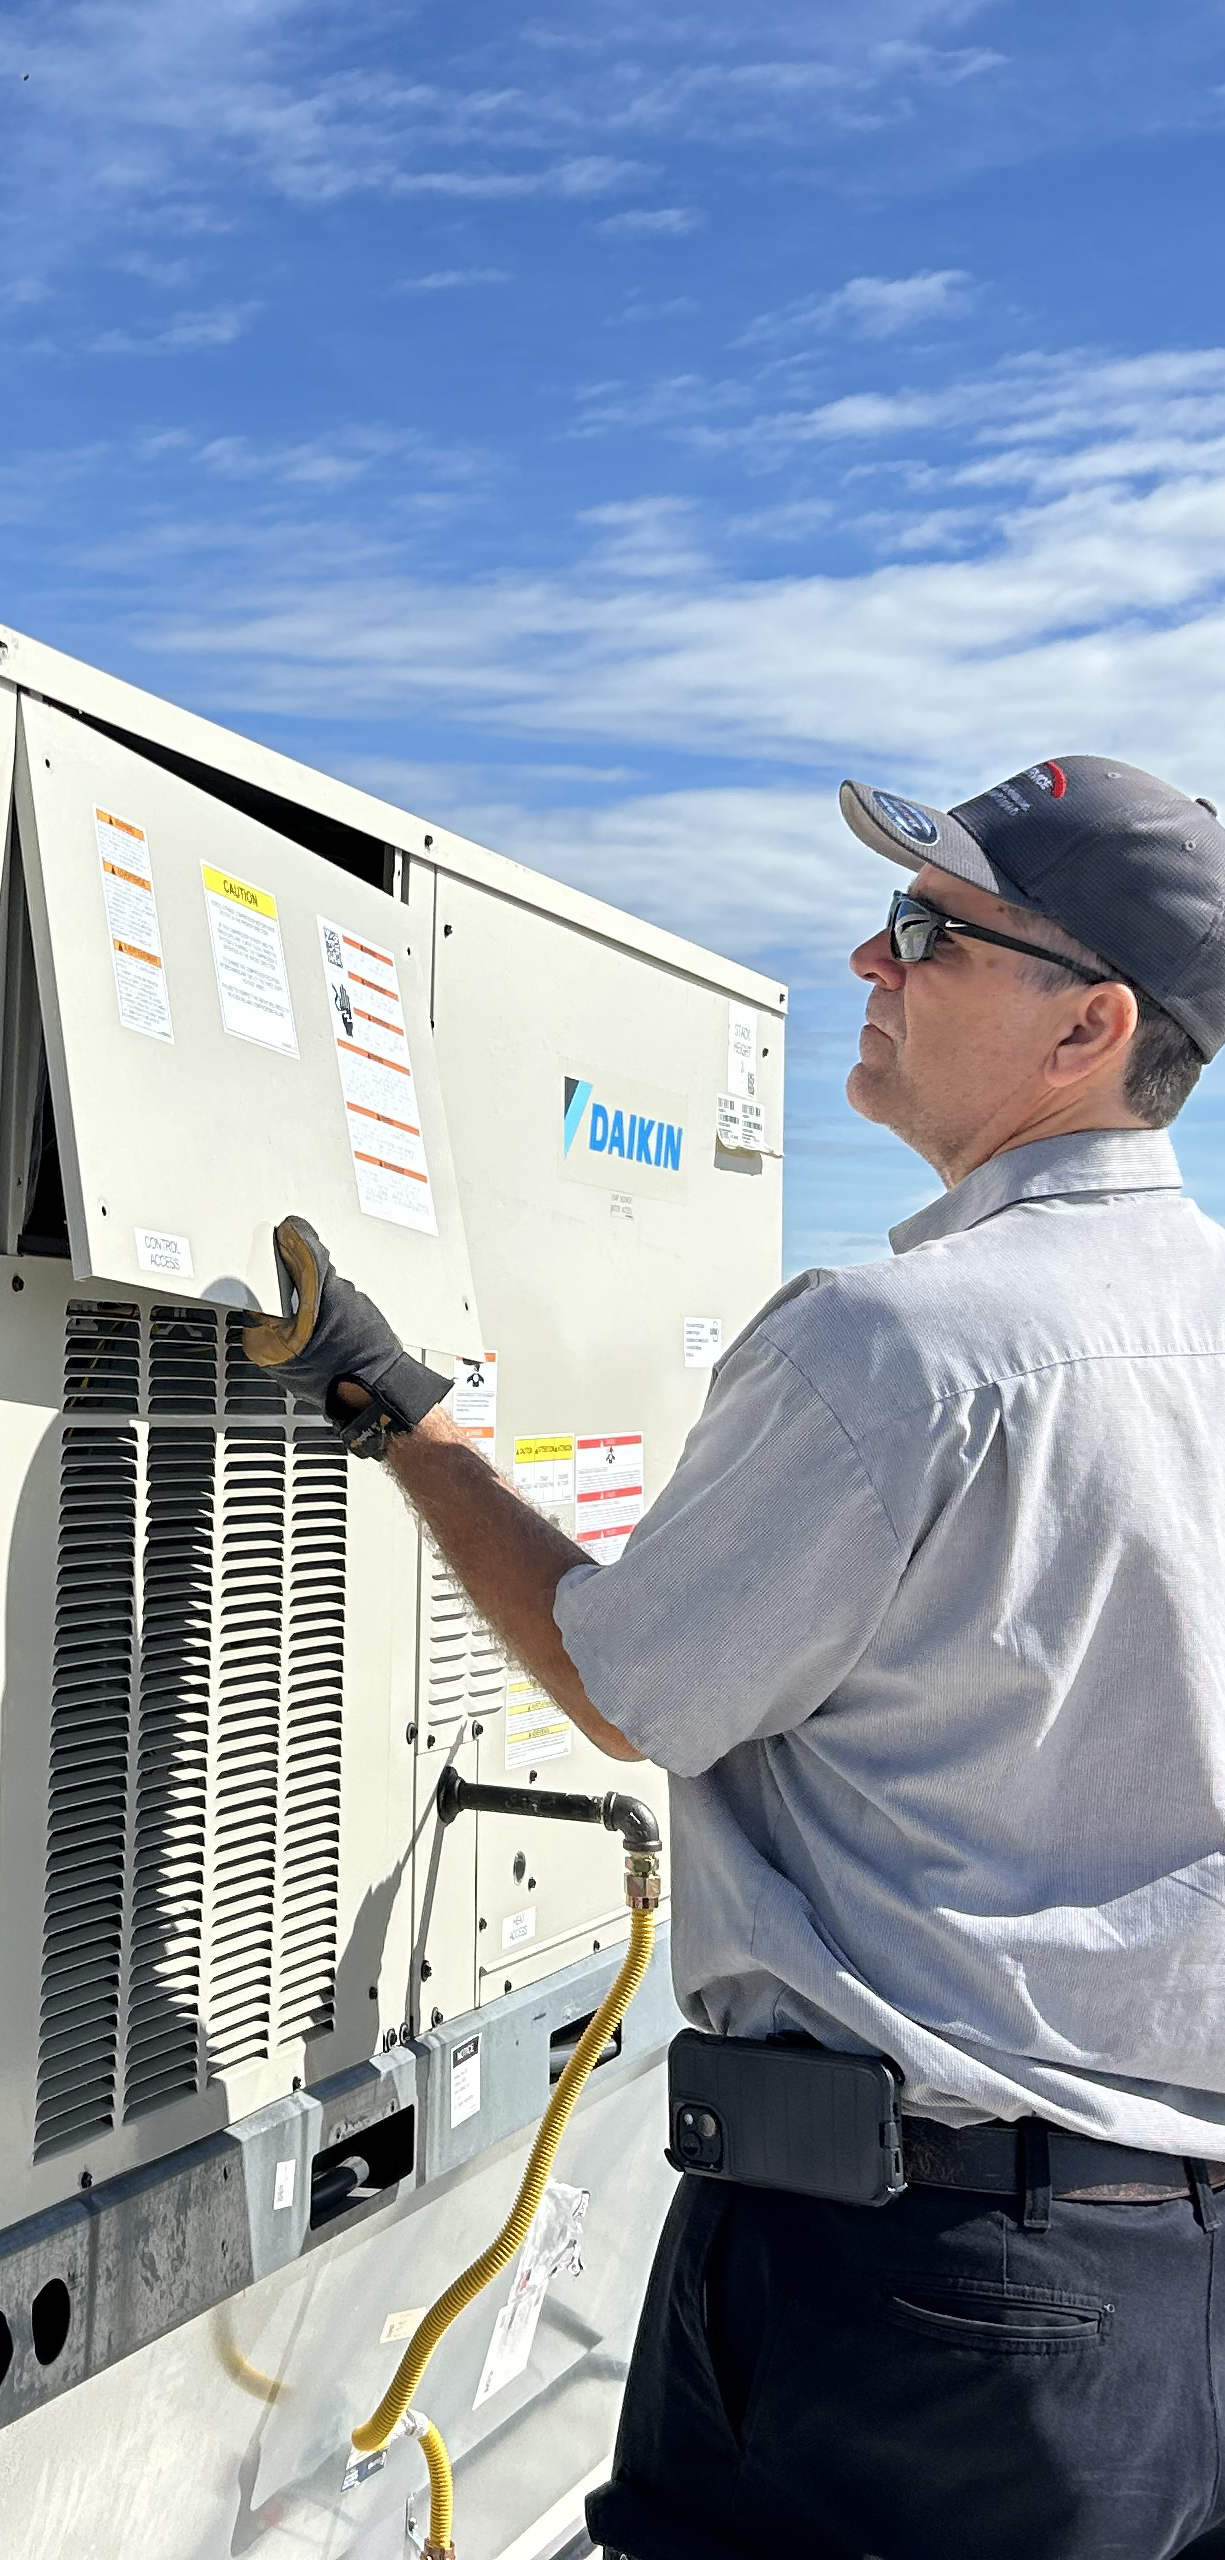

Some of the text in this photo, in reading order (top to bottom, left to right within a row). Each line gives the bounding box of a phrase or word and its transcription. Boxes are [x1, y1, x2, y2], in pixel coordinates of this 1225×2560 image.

[223, 879, 259, 907] CAUTION
[589, 1102, 683, 1171] DAIKIN
[144, 1235, 182, 1255] CONTROL
[150, 1253, 181, 1270] ACCESS
[456, 2043, 476, 2061] NOTICE
